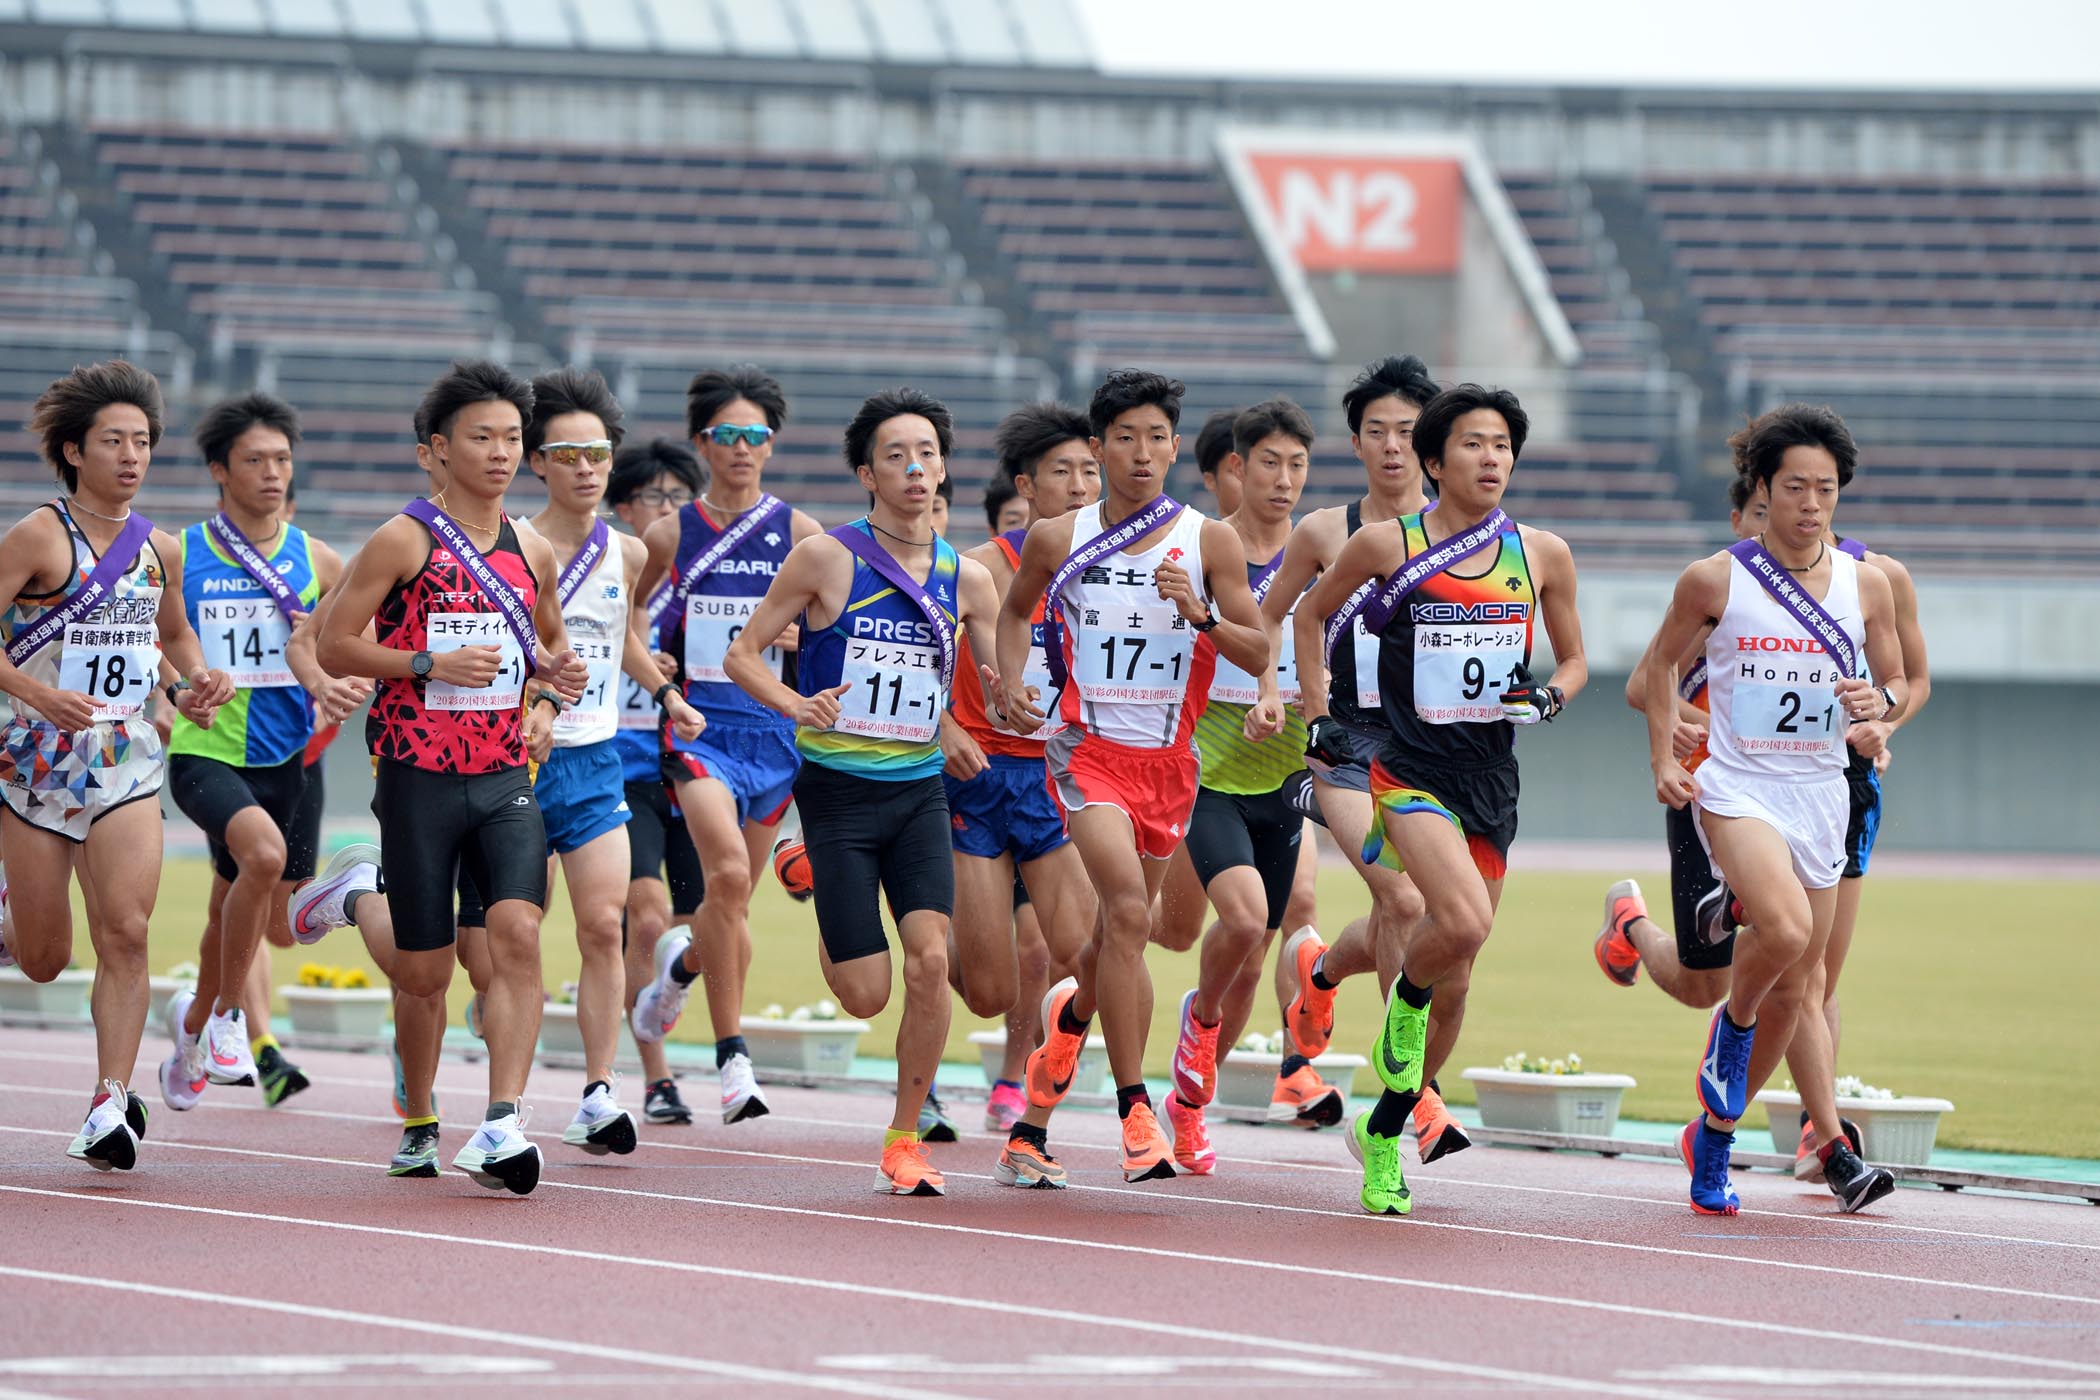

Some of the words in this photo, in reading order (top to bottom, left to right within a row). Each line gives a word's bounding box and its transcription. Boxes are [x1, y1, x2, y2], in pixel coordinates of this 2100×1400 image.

[1281, 170, 1417, 251] N2
[1081, 566, 1157, 586] 富士
[1085, 609, 1187, 630] 富士通
[1411, 602, 1531, 622] KOMORI
[71, 629, 152, 647] 自衛隊体育学校
[853, 616, 938, 645] PRES
[1420, 630, 1524, 648] 小森コーポレーション
[222, 627, 288, 667] 14-
[853, 645, 941, 671] プレス工業
[1100, 635, 1182, 681] 17-1
[1736, 637, 1826, 654] HOND
[86, 655, 154, 698] 18-1
[1741, 663, 1839, 683] Honda
[866, 671, 936, 720] 11-1
[1776, 691, 1834, 733] 2-1
